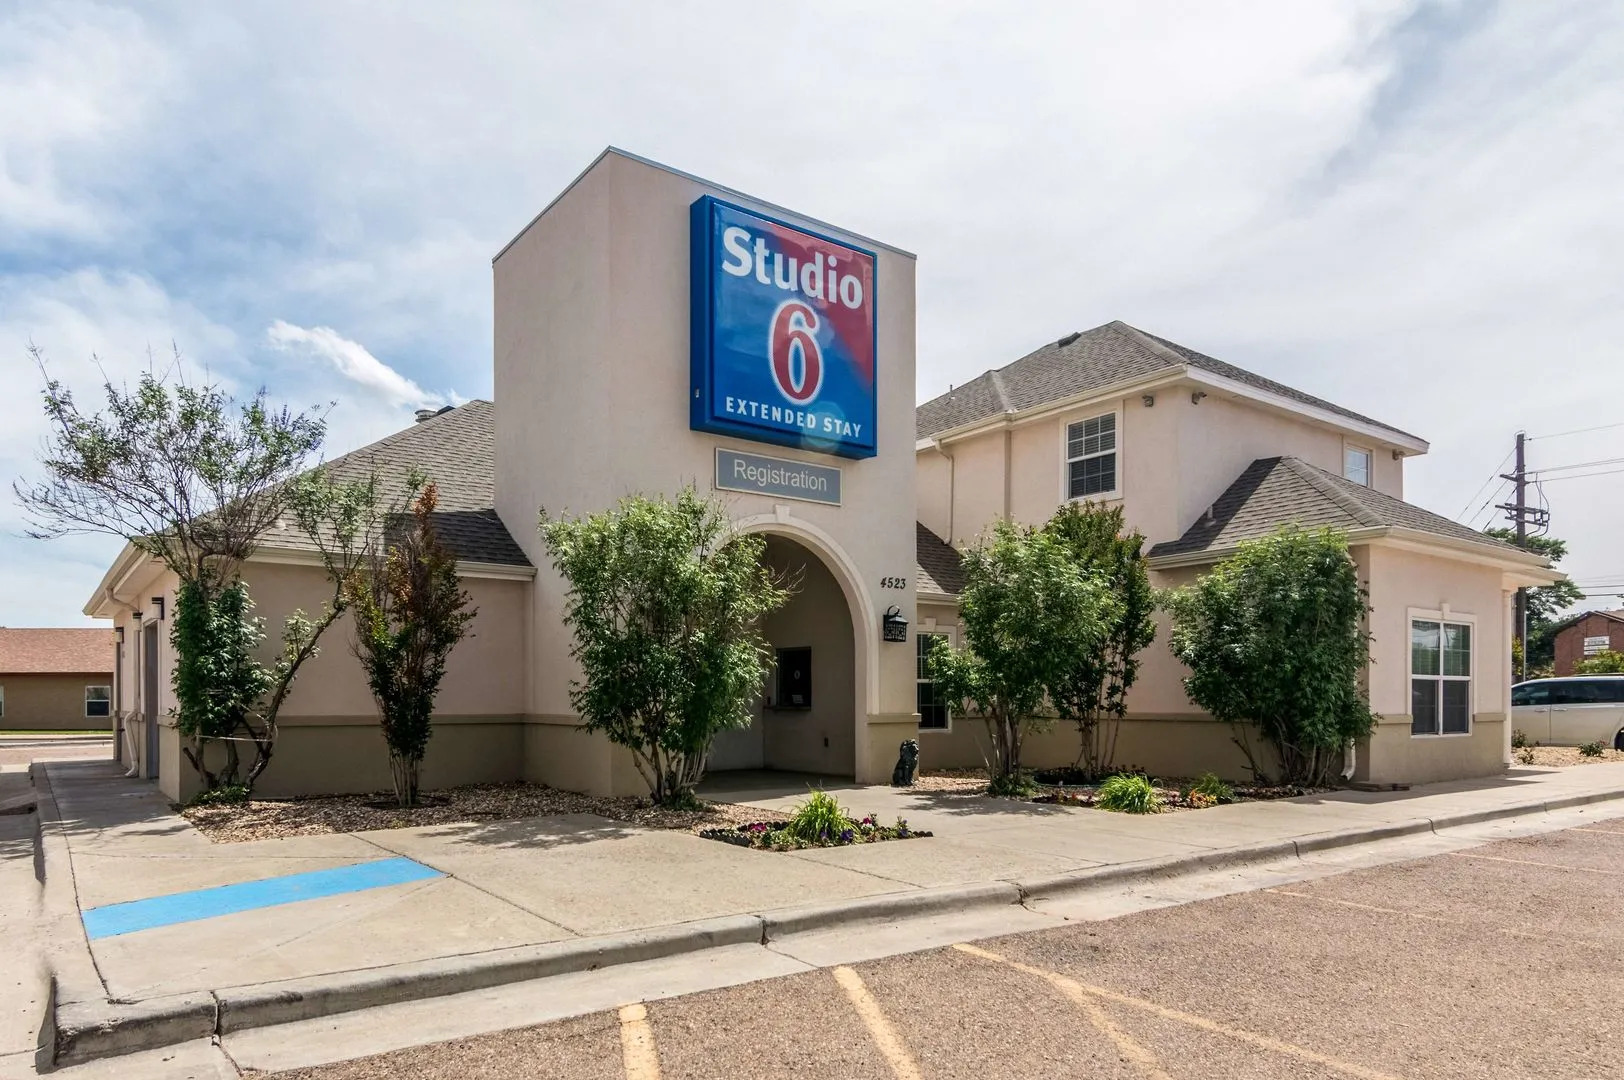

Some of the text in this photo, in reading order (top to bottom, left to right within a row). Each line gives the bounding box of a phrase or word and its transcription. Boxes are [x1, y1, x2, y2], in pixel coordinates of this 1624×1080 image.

[722, 226, 863, 309] Studio
[768, 299, 823, 405] 6
[726, 396, 861, 438] EXTENDED STAY
[734, 459, 827, 491] Registration
[880, 577, 906, 589] 4523
